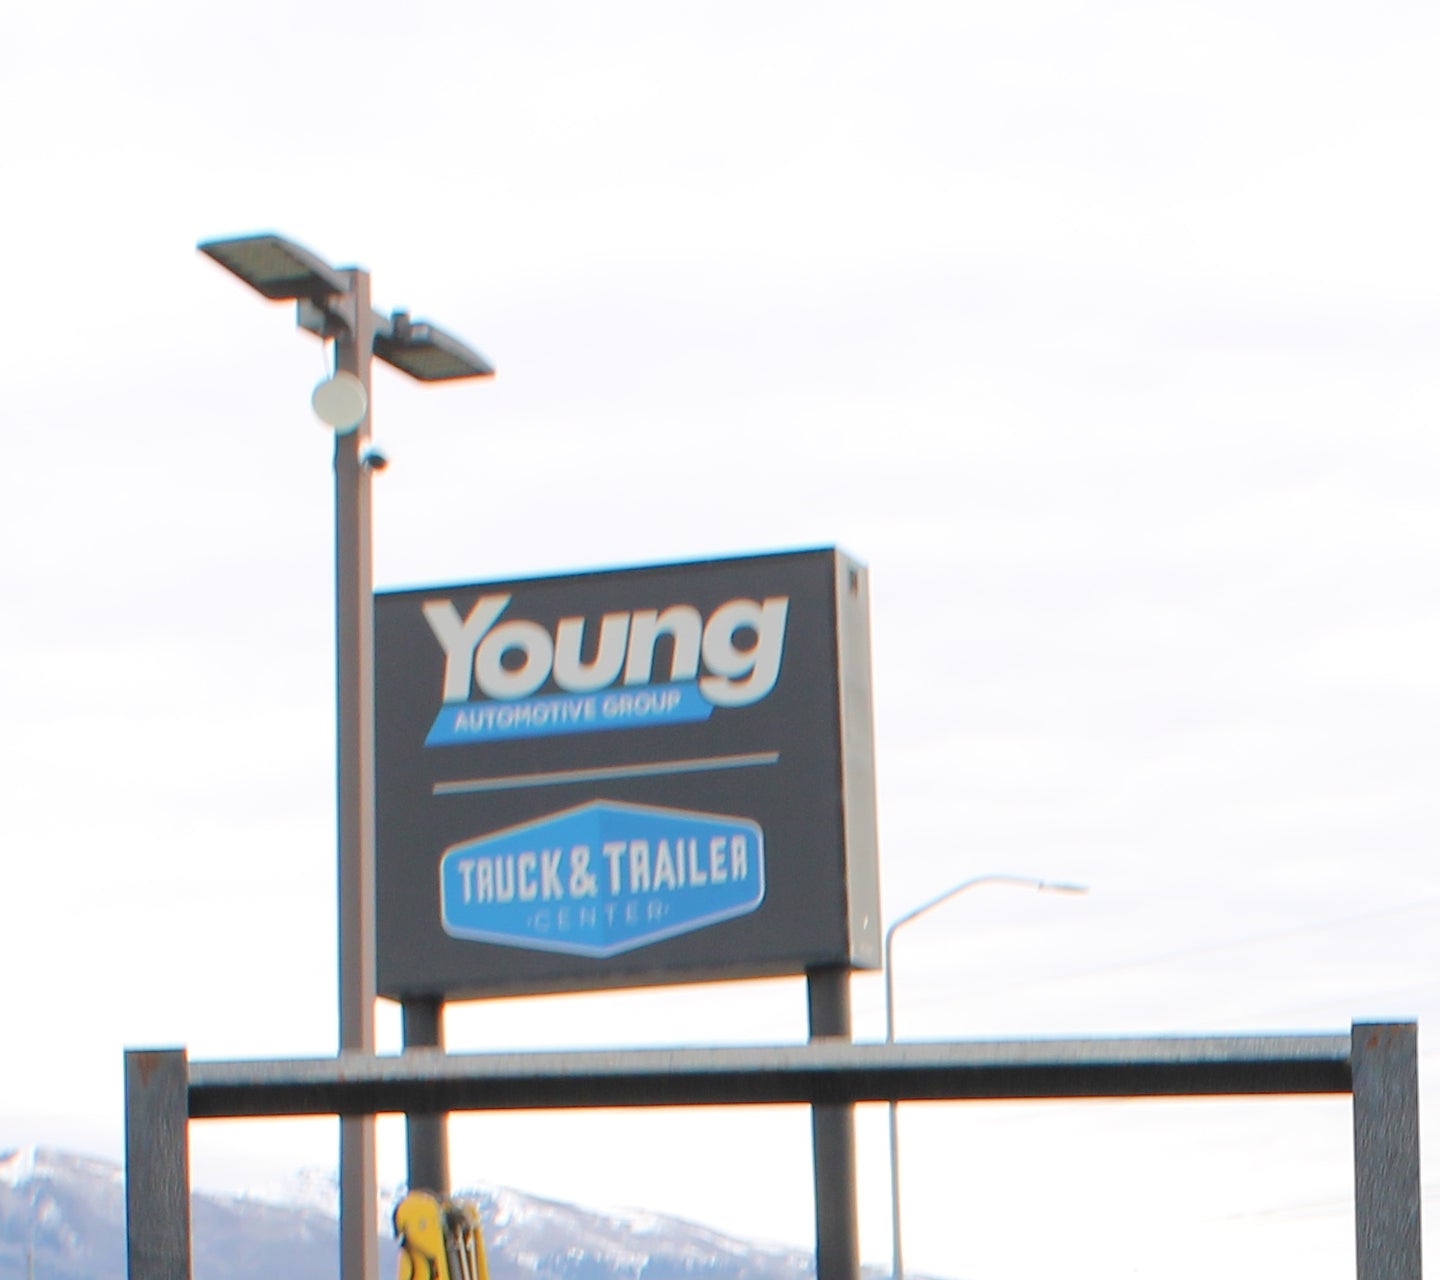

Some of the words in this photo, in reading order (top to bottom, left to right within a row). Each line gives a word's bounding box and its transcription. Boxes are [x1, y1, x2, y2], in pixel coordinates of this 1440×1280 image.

[423, 593, 789, 707] Young
[454, 697, 597, 733] AUTOMOTIVE
[602, 689, 682, 719] GROUP
[457, 848, 564, 905] TRUCK
[569, 844, 598, 898] &
[602, 835, 748, 895] TRAILER
[532, 900, 663, 931] CENTER
